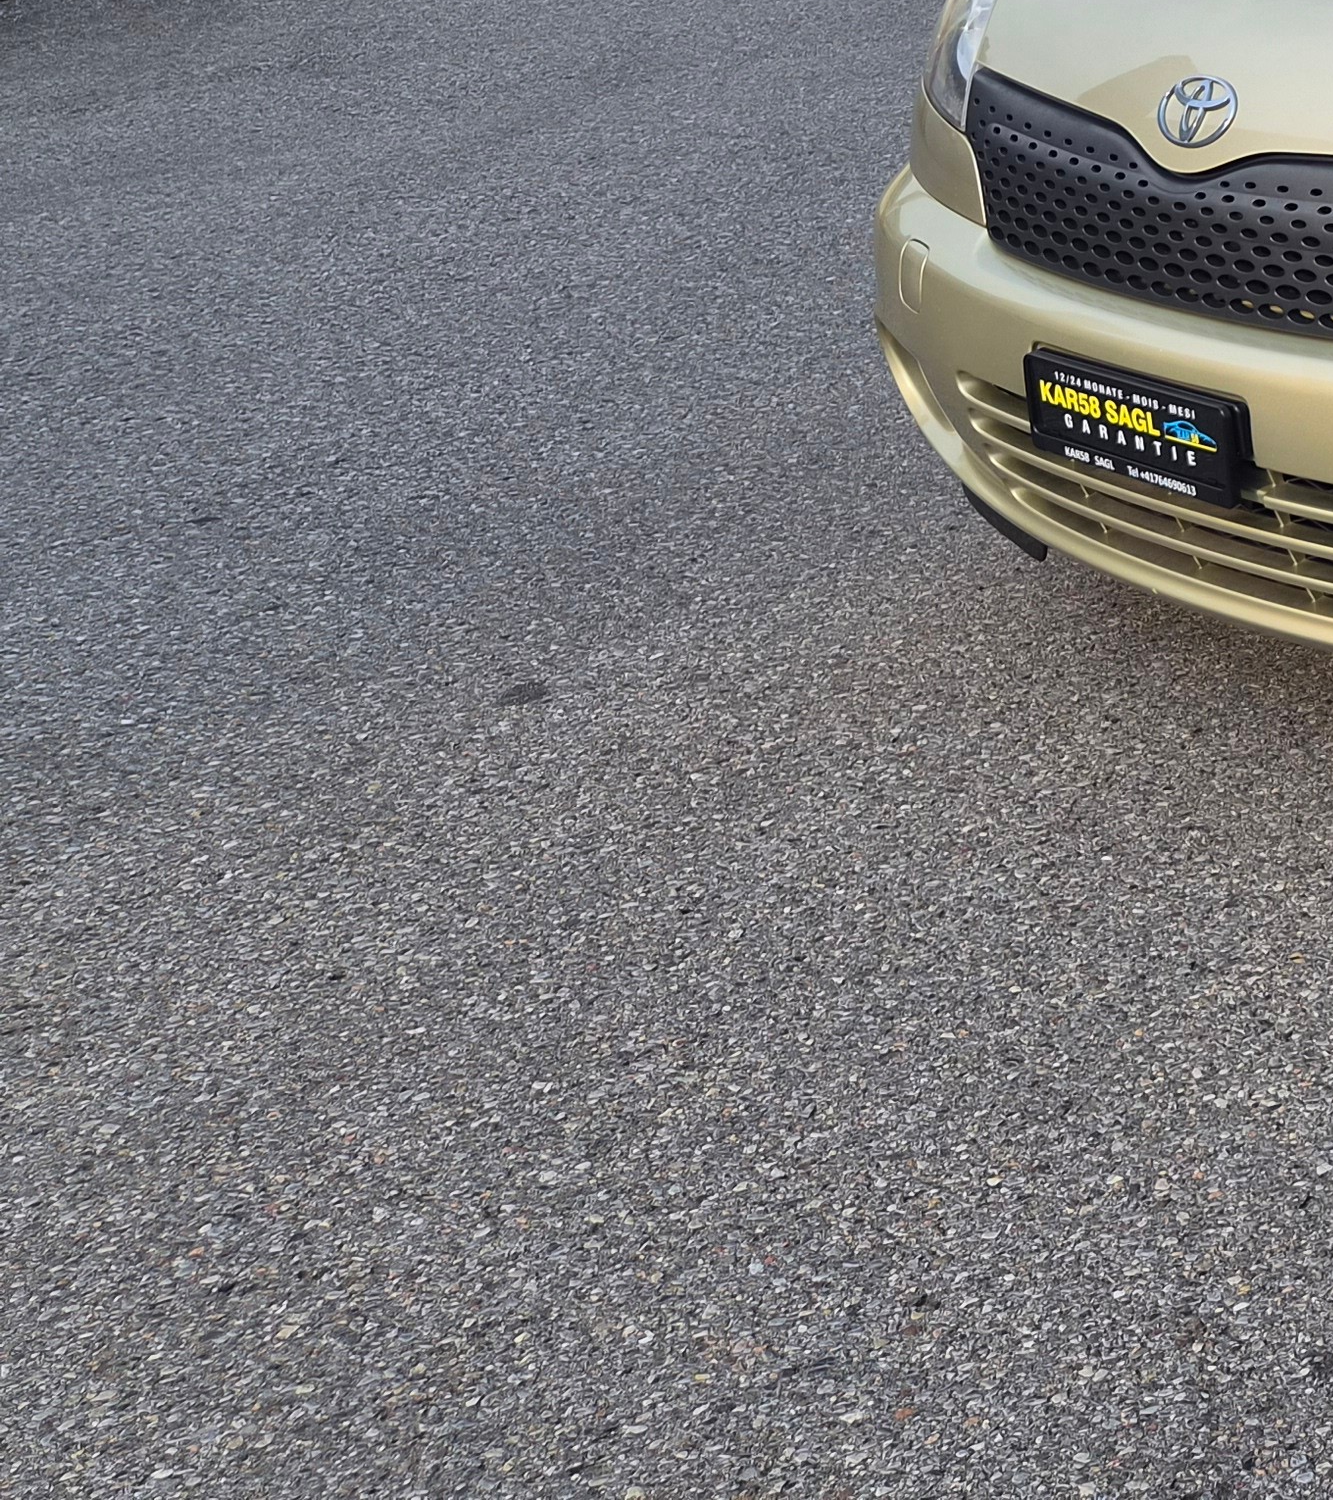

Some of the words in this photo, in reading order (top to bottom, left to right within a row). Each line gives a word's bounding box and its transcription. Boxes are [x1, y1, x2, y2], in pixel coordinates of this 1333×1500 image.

[1039, 378, 1102, 419] KAR58
[1104, 399, 1161, 437] SAGL
[1053, 370, 1082, 388] 12/24
[1083, 378, 1124, 400] MONATE
[1132, 393, 1159, 411] MOIS
[1168, 403, 1196, 420] MESI
[1063, 413, 1197, 467] GARANTIE
[1064, 445, 1091, 463] KAR58
[1094, 455, 1116, 471] SAGL
[1126, 464, 1139, 478] Tel
